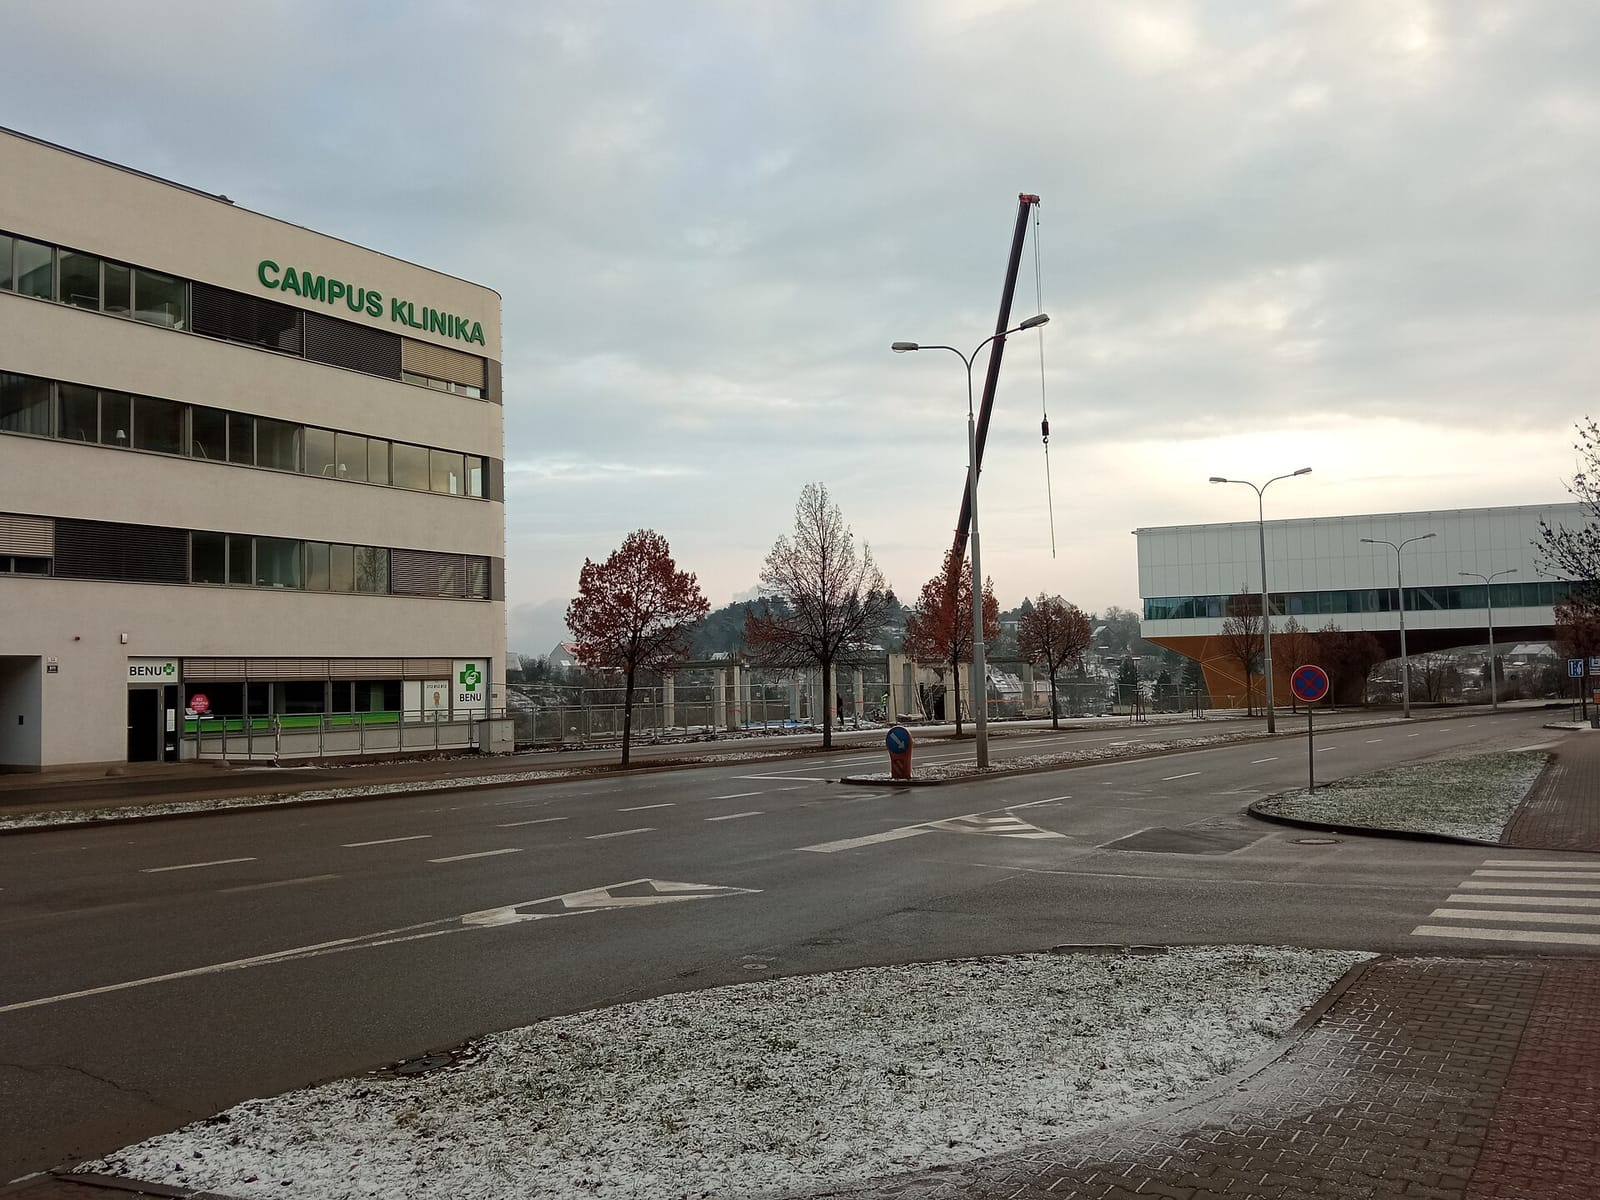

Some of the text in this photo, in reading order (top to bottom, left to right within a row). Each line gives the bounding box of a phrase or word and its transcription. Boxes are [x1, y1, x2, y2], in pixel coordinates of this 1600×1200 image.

[258, 260, 485, 346] CAMPUS KLINIKA
[129, 666, 162, 676] BENU
[459, 693, 482, 702] BENU
